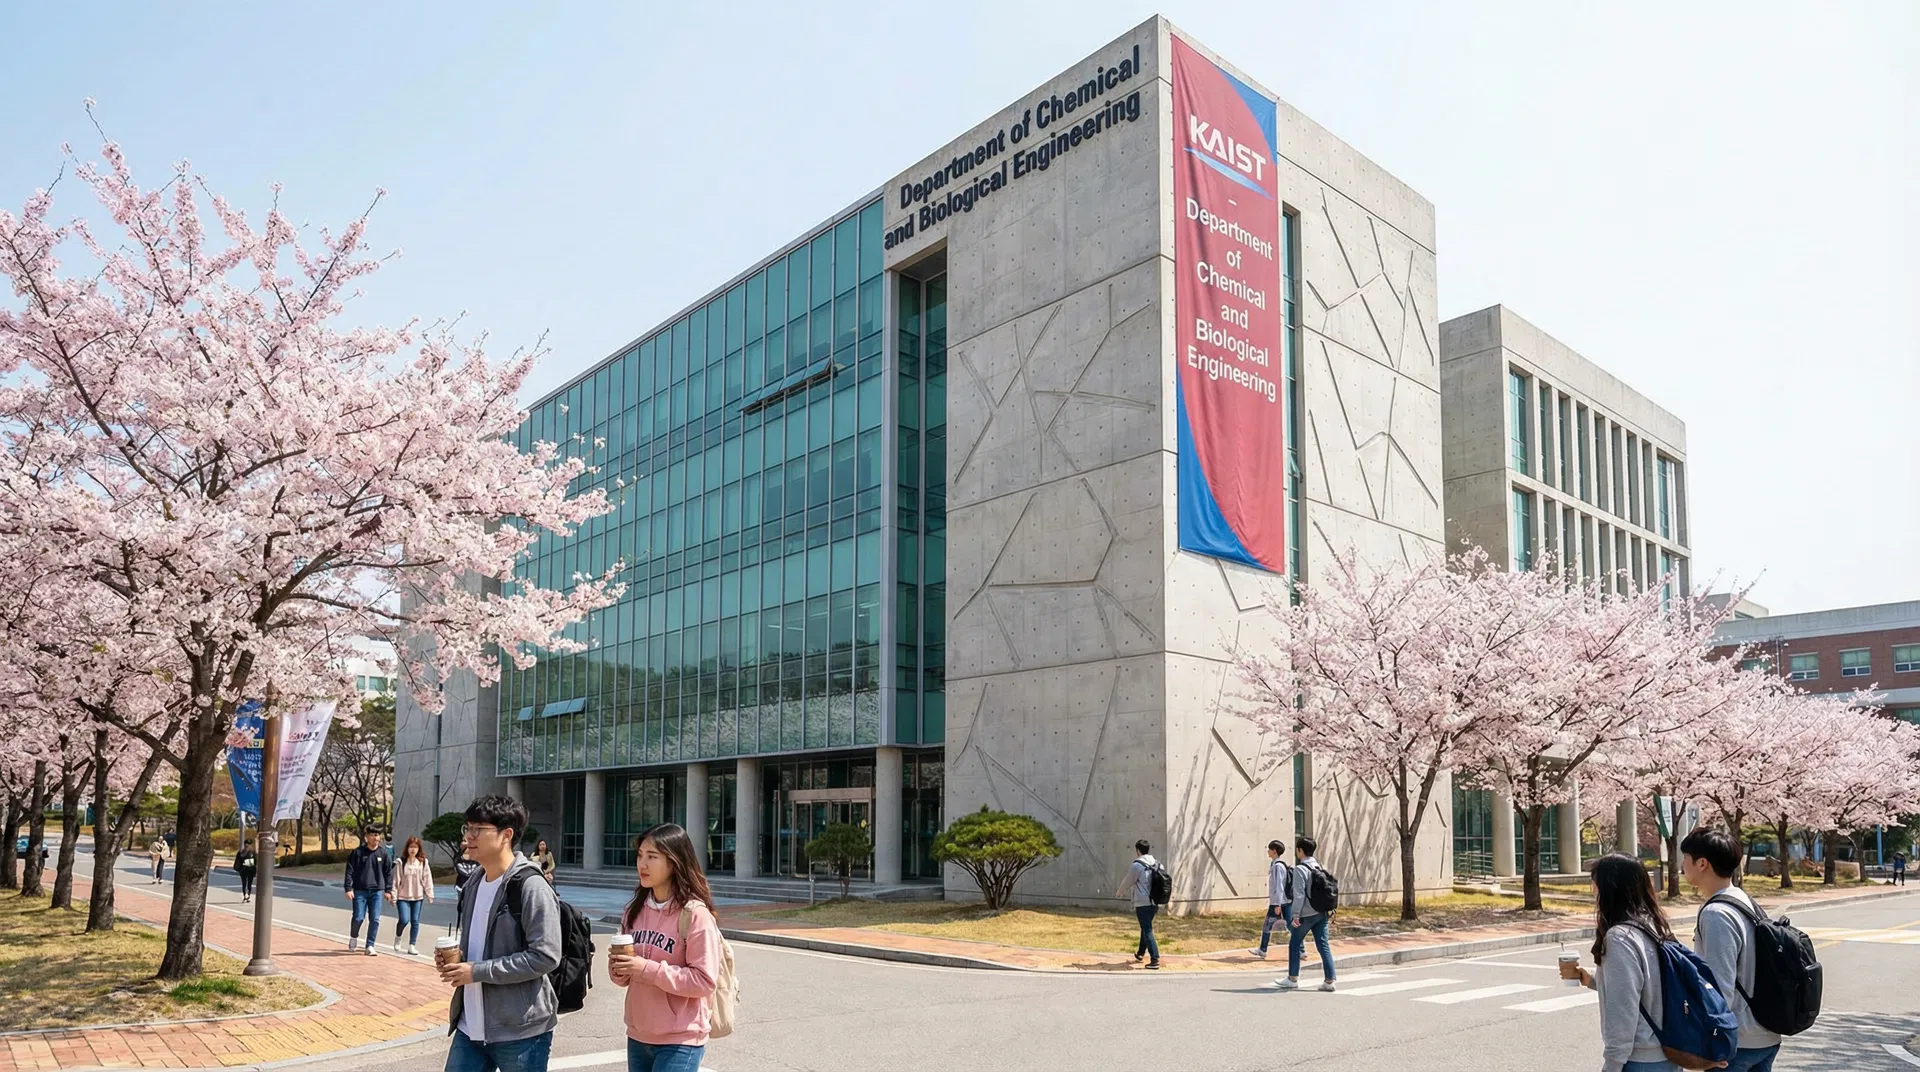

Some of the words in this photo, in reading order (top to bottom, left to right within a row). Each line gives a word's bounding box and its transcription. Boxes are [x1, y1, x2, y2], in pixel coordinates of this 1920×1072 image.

[900, 129, 1005, 209] Department
[1010, 108, 1031, 144] of
[1036, 44, 1140, 129] Chemical
[1190, 114, 1267, 181] KAIST
[884, 214, 914, 250] and
[919, 160, 1008, 232] Biological
[1013, 91, 1140, 179] Engineering
[1186, 197, 1273, 261] Department
[1196, 261, 1266, 310] Chemical
[1226, 250, 1242, 270] of
[1195, 318, 1269, 367] Biological
[1220, 304, 1249, 330] and
[1187, 344, 1276, 403] Engineering
